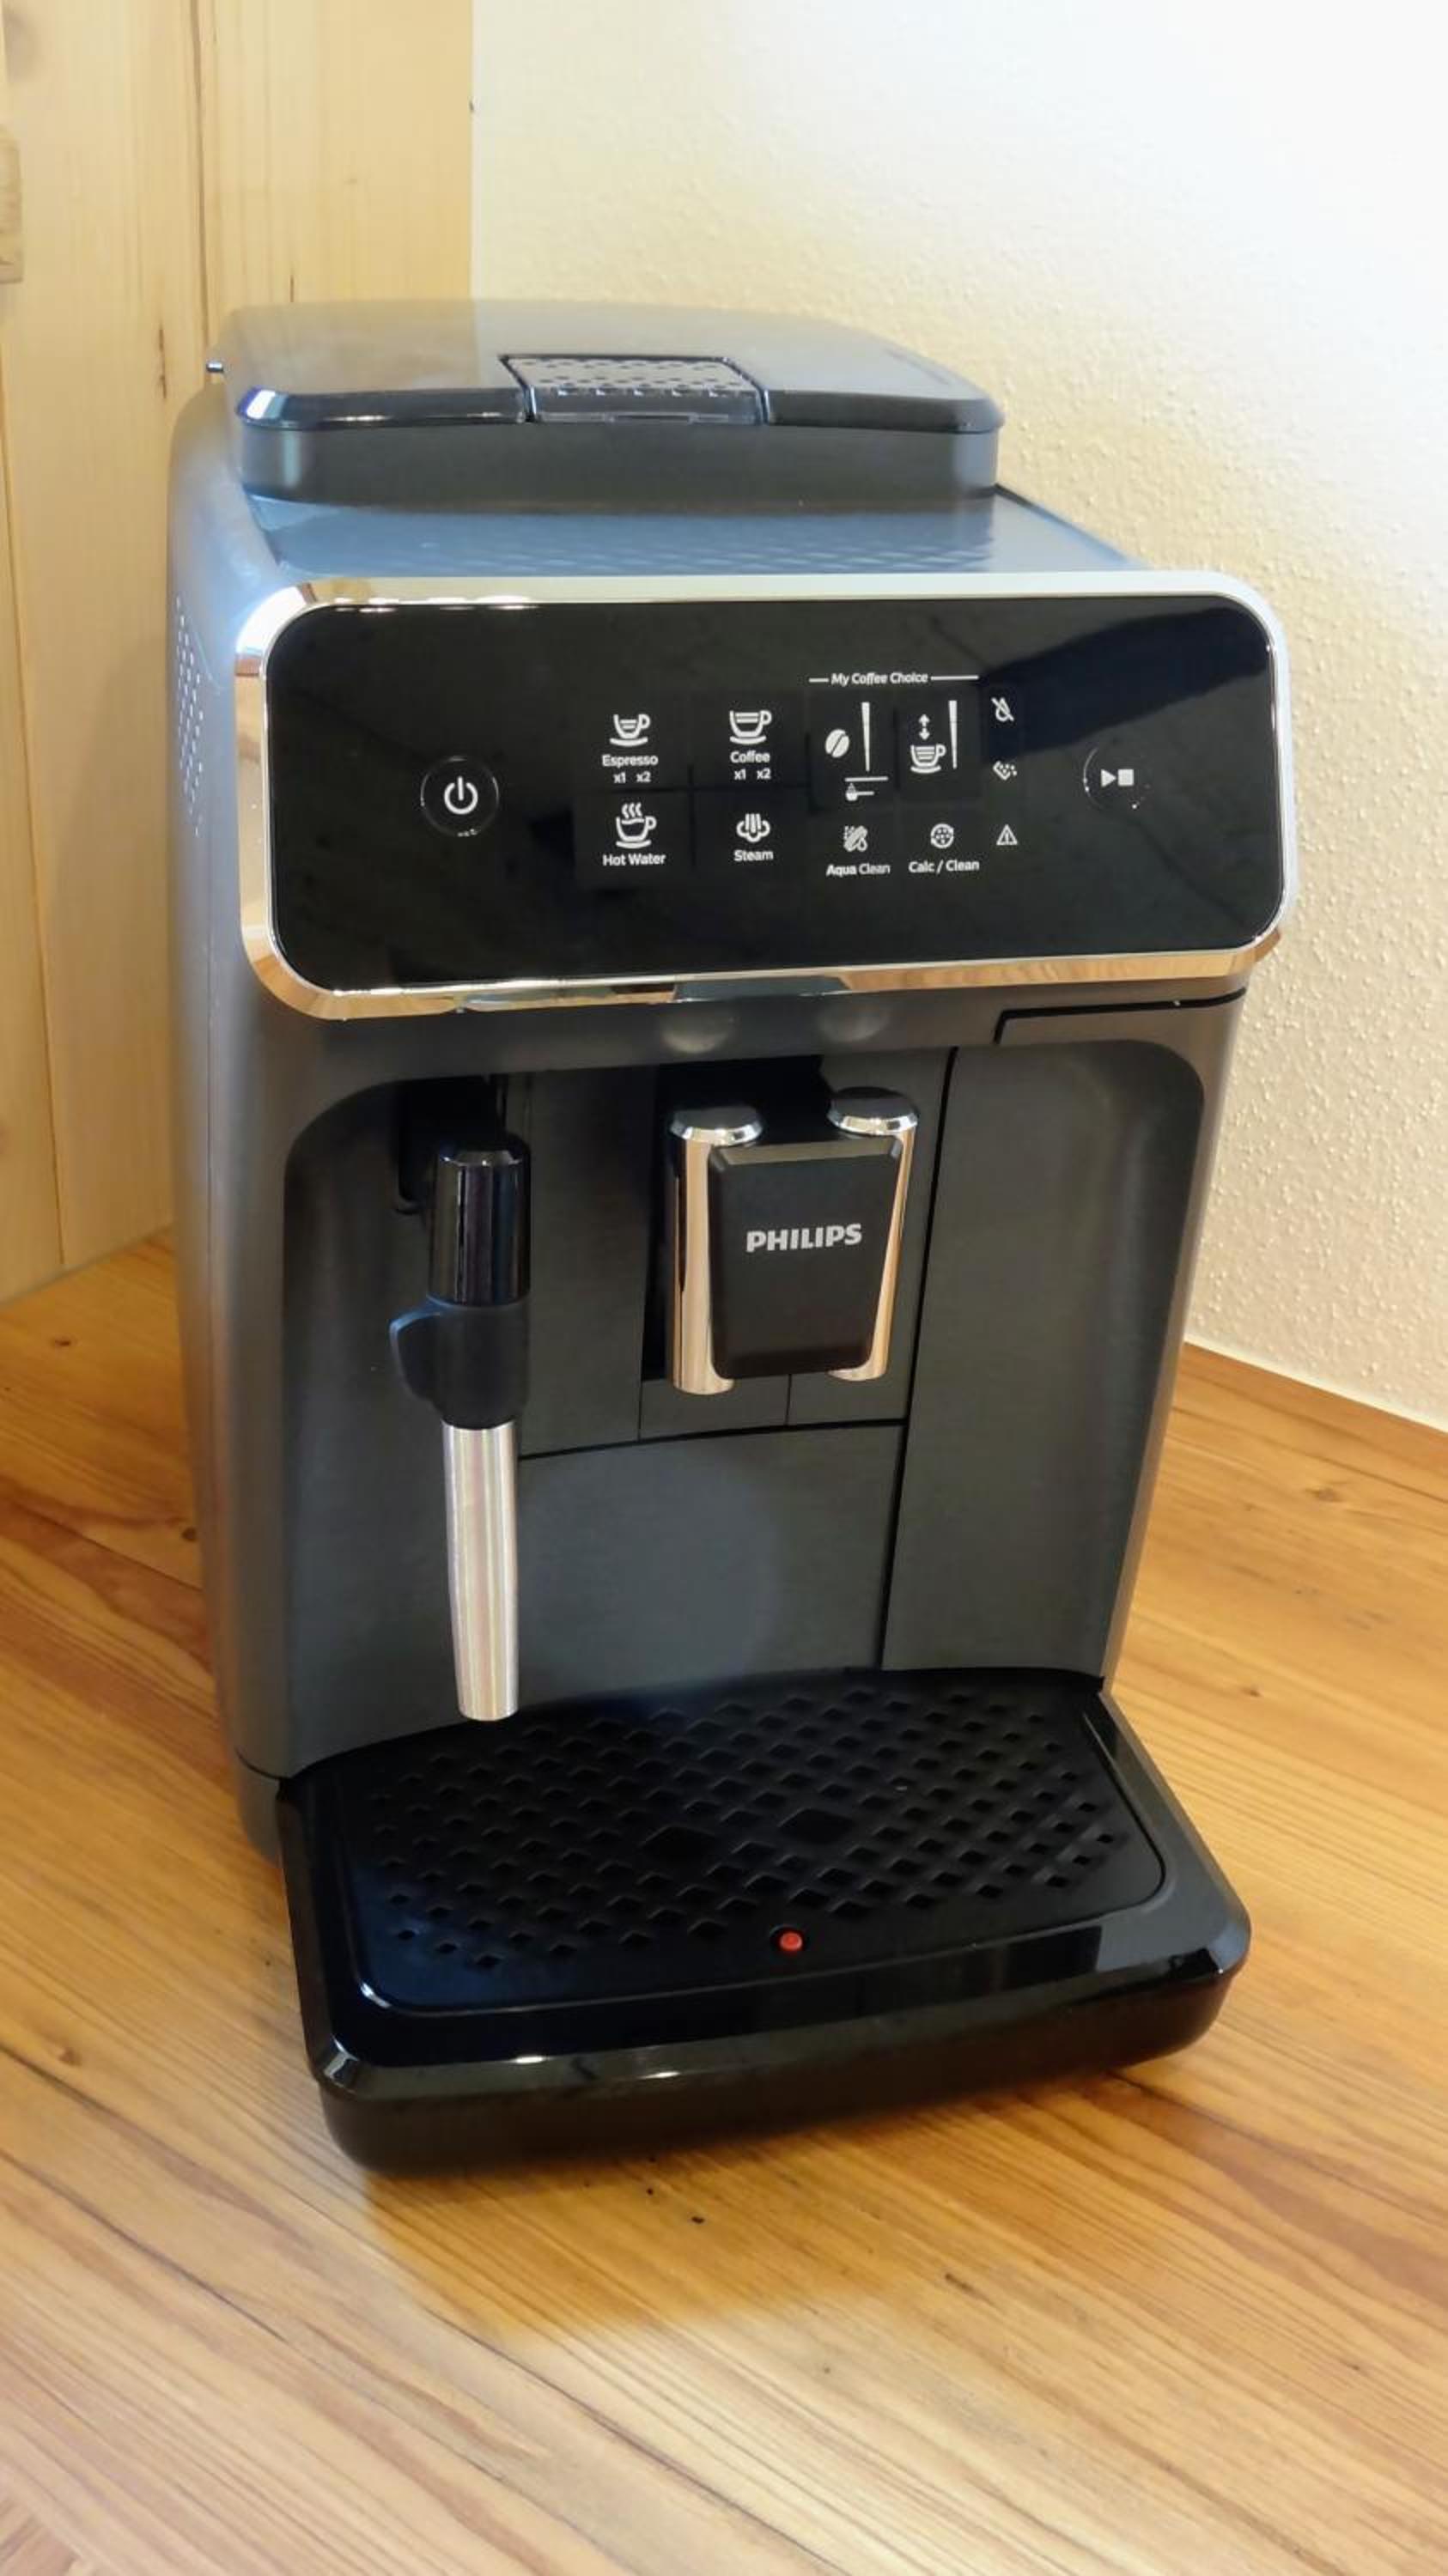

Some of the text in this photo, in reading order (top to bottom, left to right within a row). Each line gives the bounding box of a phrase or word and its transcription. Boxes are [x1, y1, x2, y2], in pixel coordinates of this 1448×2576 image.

[830, 671, 928, 687] My Coffee Choice
[601, 754, 659, 769] Espresso
[730, 750, 770, 763] Coffee
[613, 770, 651, 784] x1 x2
[734, 767, 771, 781] x1 x2
[602, 853, 666, 866] Hot Water
[733, 849, 774, 862] Steam
[825, 862, 891, 878] Aqua Clean
[908, 860, 935, 873] Calc
[945, 859, 980, 872] Clean
[746, 1223, 862, 1253] PHILIPS
